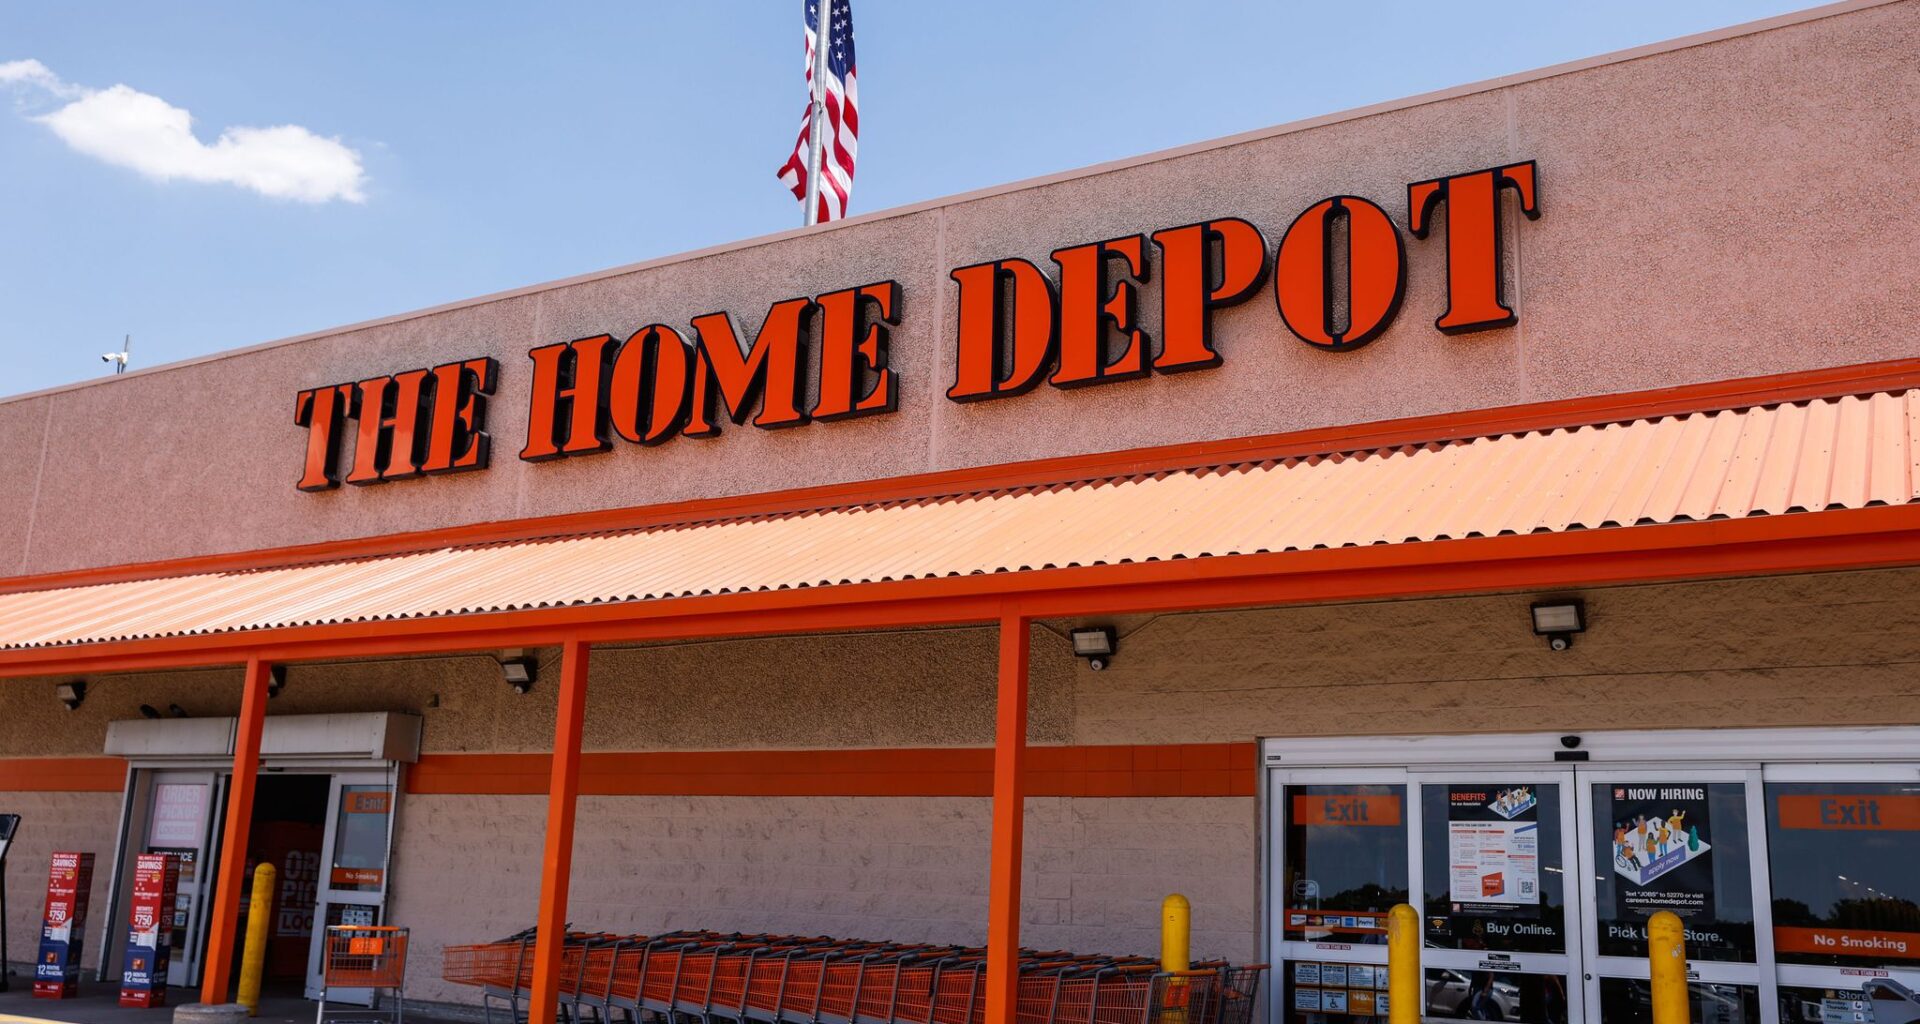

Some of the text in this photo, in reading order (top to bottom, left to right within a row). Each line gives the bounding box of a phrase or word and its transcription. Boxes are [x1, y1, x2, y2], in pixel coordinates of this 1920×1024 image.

[295, 159, 1541, 492] THE HOME DEPOT
[162, 784, 199, 802] ORDER
[1451, 793, 1486, 801] BENEFITS
[1628, 788, 1704, 800] NOW HIRING
[160, 804, 199, 818] PICKUP
[1324, 799, 1369, 822] Exit
[1820, 799, 1881, 825] Exit
[52, 859, 77, 868] SAVINGS
[137, 861, 162, 870] SAVINGS
[1648, 855, 1680, 875] apply now
[354, 872, 378, 882] Smoking
[49, 910, 66, 920] $750
[135, 914, 152, 926] $750
[1486, 922, 1556, 936] Buy Online.
[1608, 926, 1638, 938] Pick
[1683, 929, 1724, 942] Store.
[1814, 934, 1907, 952] No Smoking
[38, 964, 46, 976] 12
[124, 971, 132, 982] 12
[1838, 990, 1868, 1001] Store
